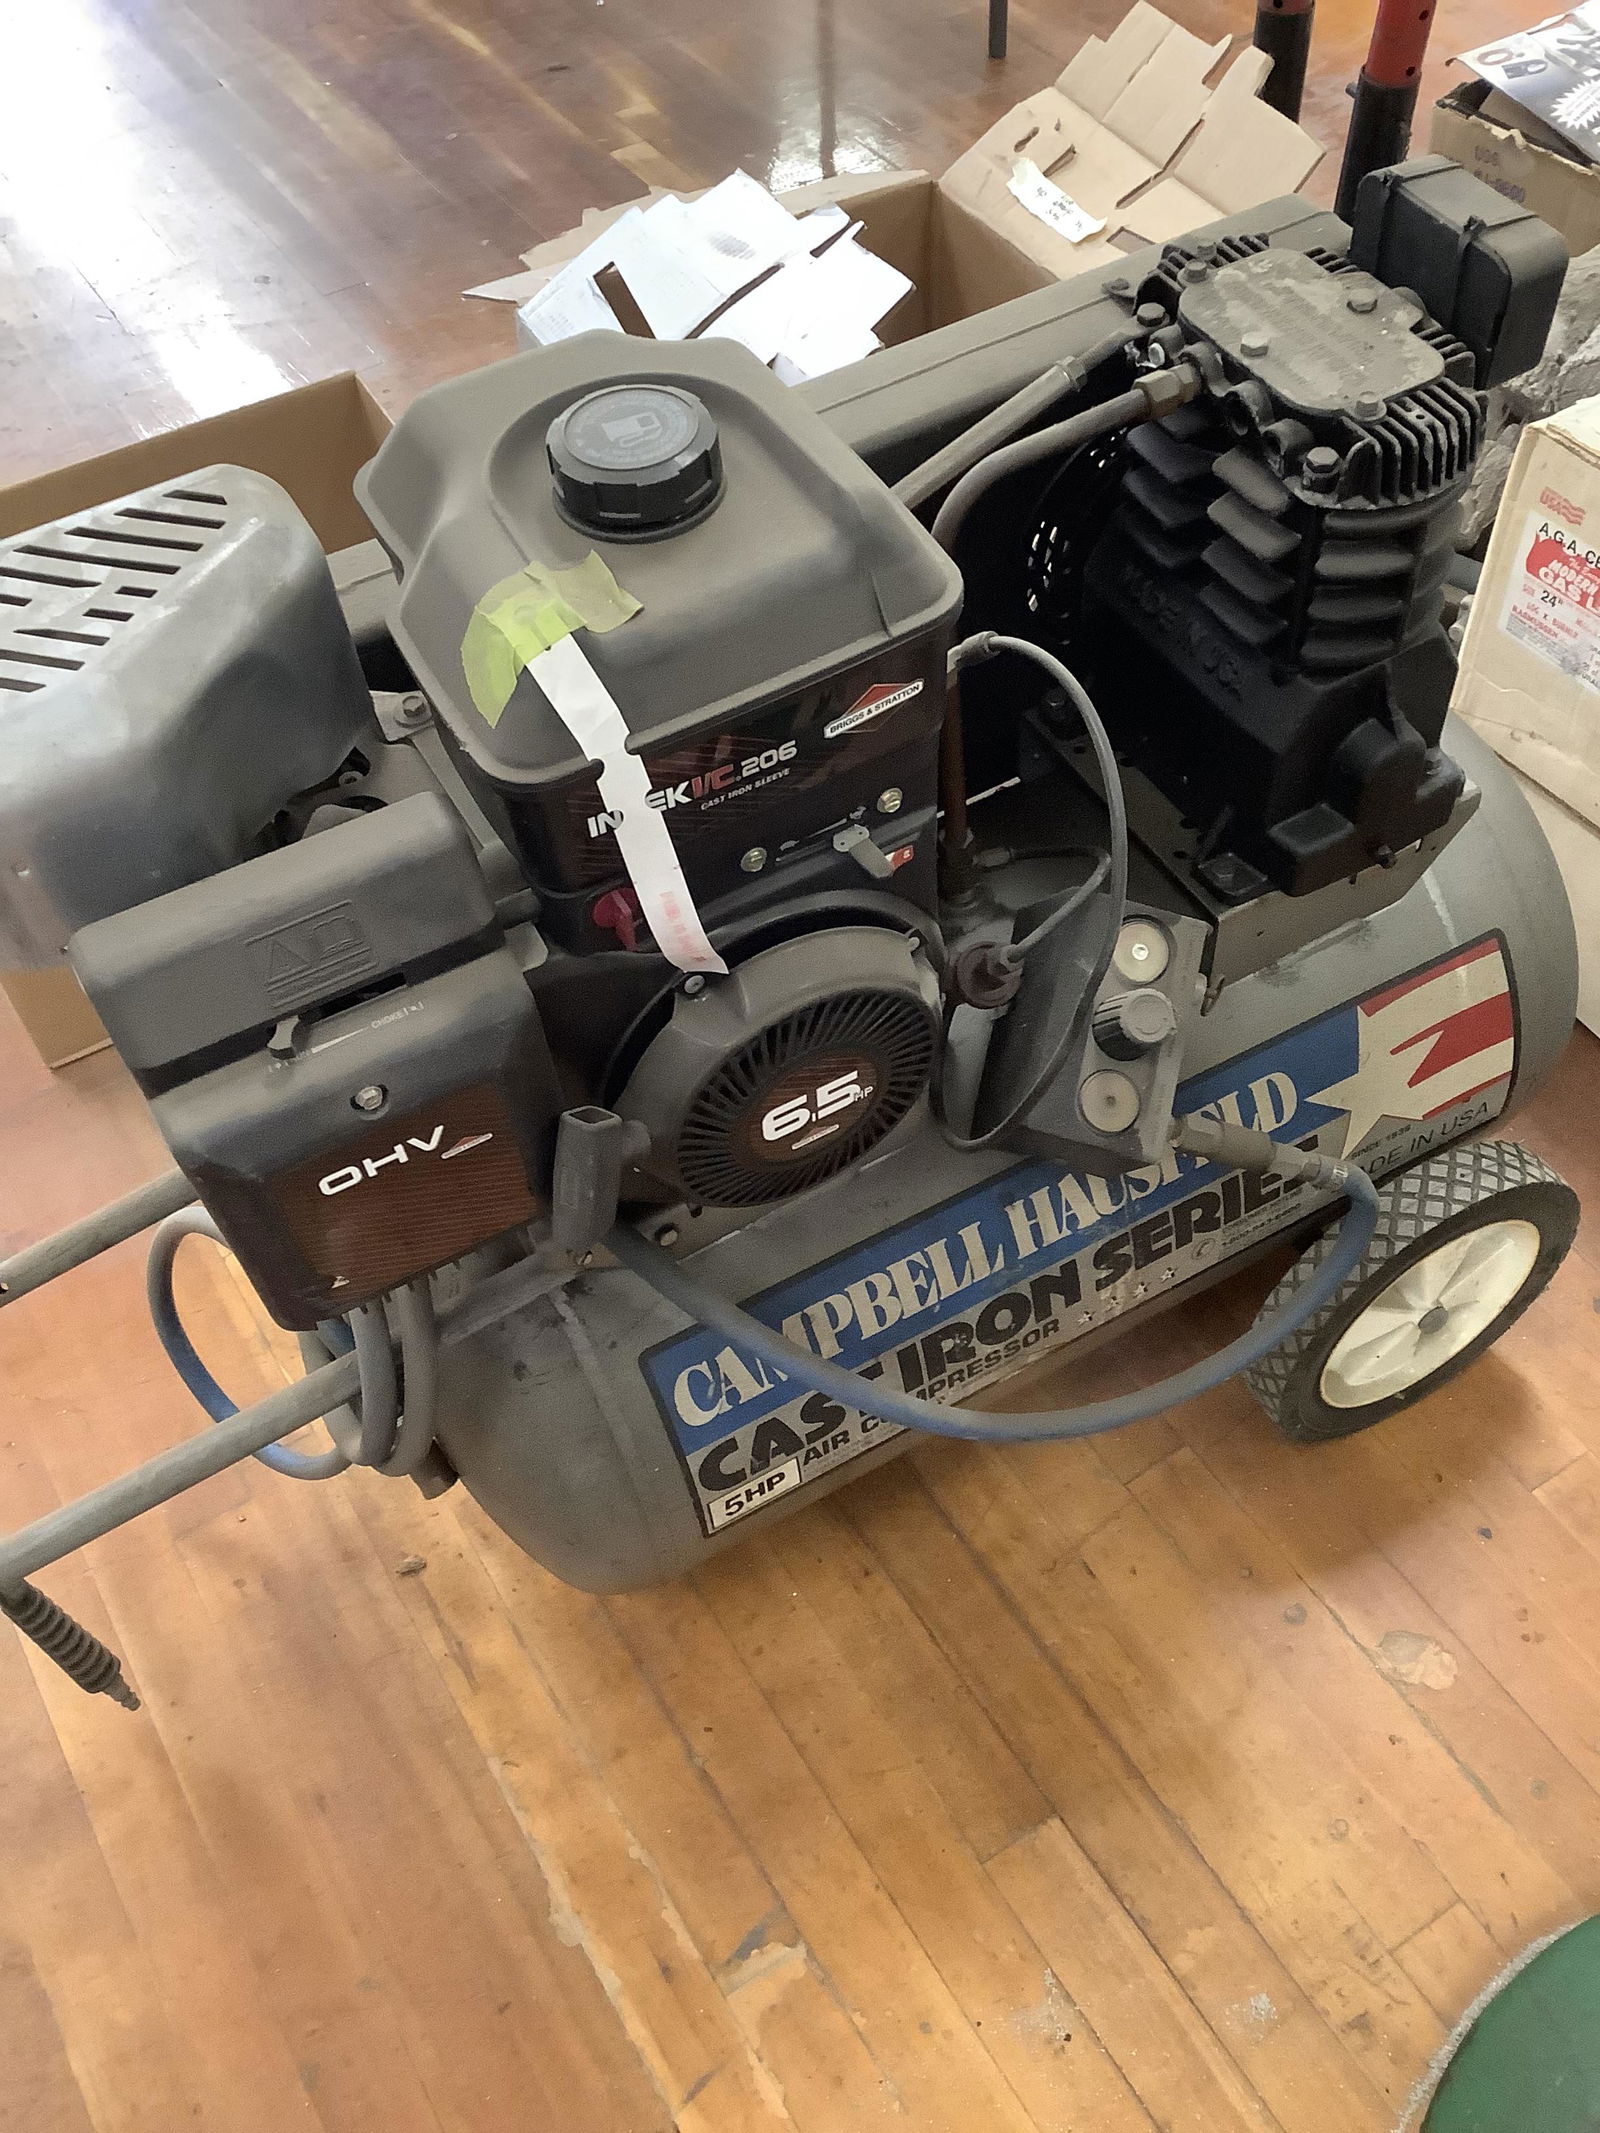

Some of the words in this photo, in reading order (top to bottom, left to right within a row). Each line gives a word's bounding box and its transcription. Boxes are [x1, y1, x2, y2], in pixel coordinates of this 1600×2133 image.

[1539, 522, 1581, 556] A.G.A.
[1539, 566, 1582, 602] GAS
[1548, 559, 1599, 596] MODERN
[829, 711, 865, 734] BRIGGS
[866, 707, 873, 716] &
[874, 684, 920, 711] STRATTON
[701, 794, 726, 811] CAST
[728, 784, 753, 799] IRON
[754, 767, 790, 788] SLEEVE
[371, 1006, 404, 1029] CHOKE
[762, 1070, 861, 1141] 6.5
[853, 1085, 873, 1102] HP
[318, 1124, 445, 1196] OHV
[1360, 1146, 1403, 1174] DE
[1411, 1129, 1434, 1153] IN
[1440, 1101, 1488, 1136] USA
[698, 1361, 883, 1493] CAS
[896, 1258, 1082, 1394] IRON
[724, 1471, 787, 1517] 5HP
[803, 1428, 850, 1467] AIR
[861, 1318, 1061, 1435] CPRESSOR
